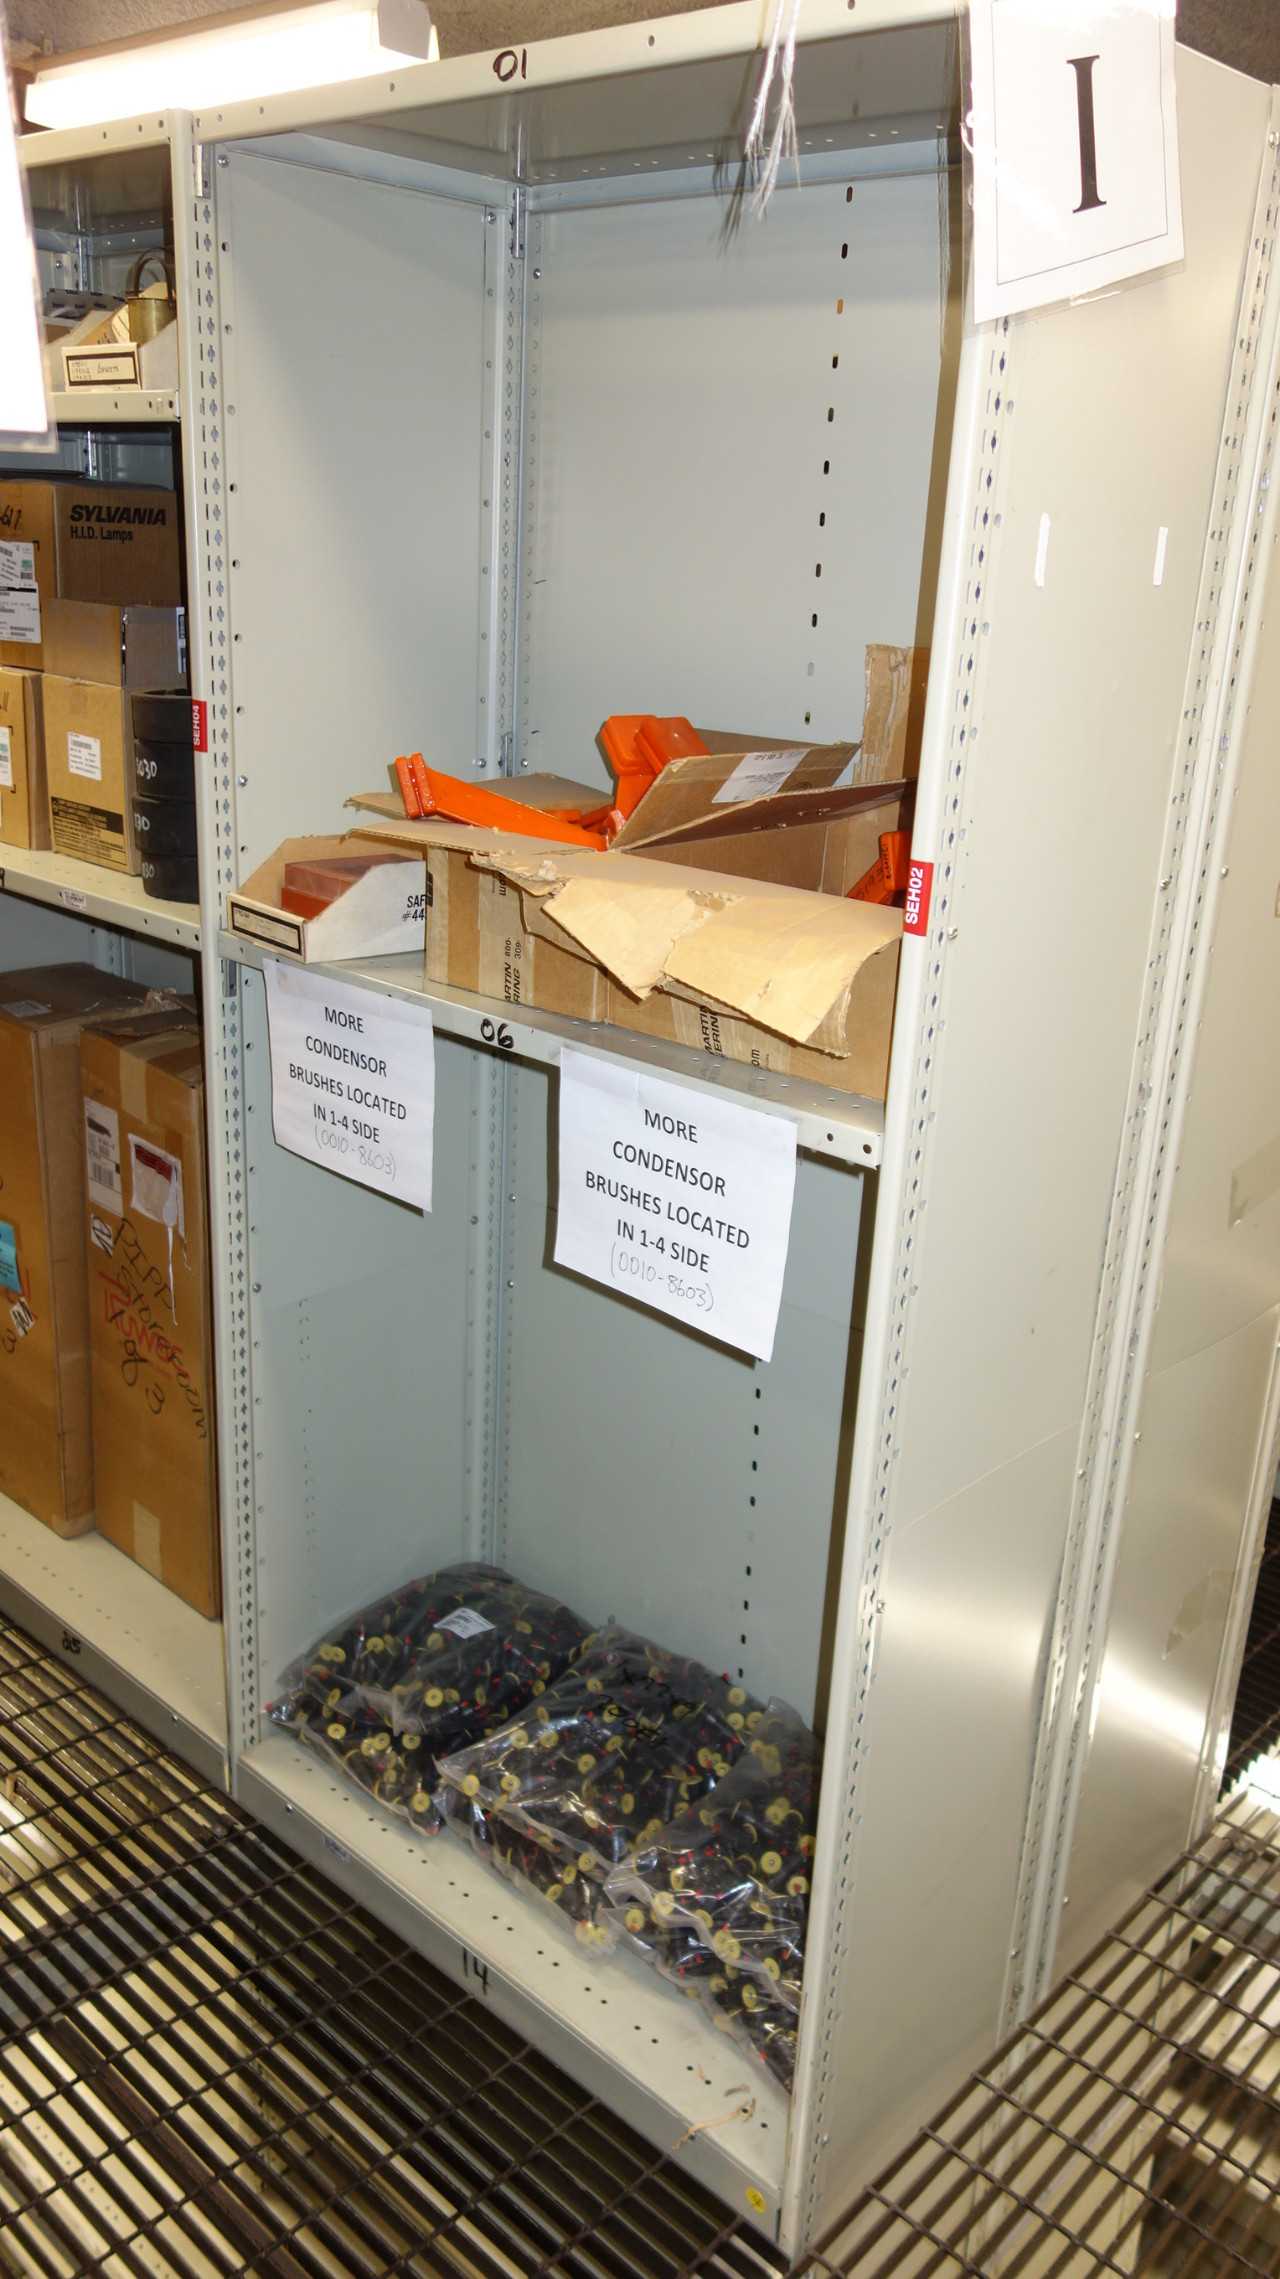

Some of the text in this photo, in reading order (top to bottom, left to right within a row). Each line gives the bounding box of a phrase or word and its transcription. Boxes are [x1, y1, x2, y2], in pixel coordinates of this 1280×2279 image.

[493, 48, 527, 82] 01
[70, 505, 167, 526] SYLVANIA
[70, 526, 133, 544] H.I.D. Lamps
[192, 704, 201, 746] SEH04
[904, 867, 924, 925] SEH02
[324, 1006, 365, 1033] MORE
[481, 1018, 514, 1049] 06
[305, 1035, 387, 1078] CONDENSOR
[289, 1063, 407, 1120] BRUSHES LOCATED
[313, 1103, 380, 1144] IN 1-4 SIDE
[644, 1109, 698, 1144] MORE
[613, 1140, 726, 1197] CONDENSOR
[585, 1170, 750, 1249] BRUSHES LOCATED
[617, 1218, 710, 1273] IN 1-4 SIDE
[610, 1241, 714, 1312] (0010-8603)
[463, 1947, 488, 1996] 14
